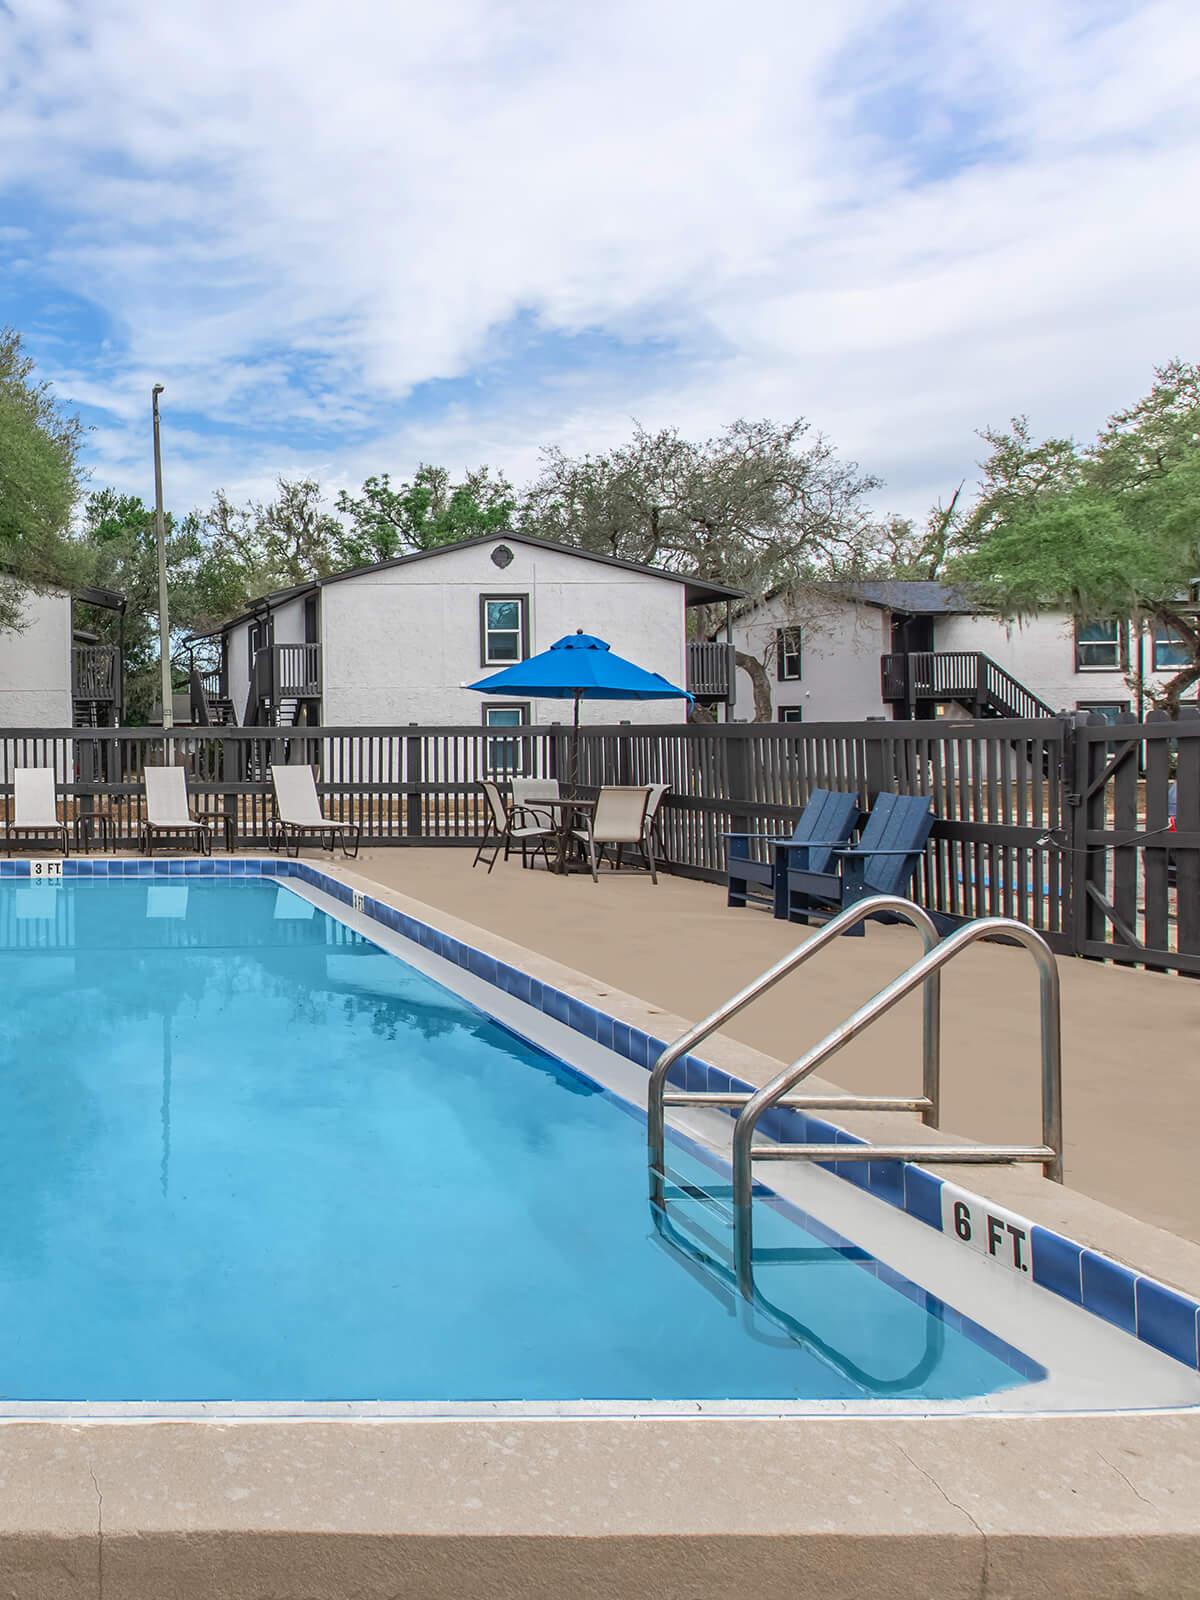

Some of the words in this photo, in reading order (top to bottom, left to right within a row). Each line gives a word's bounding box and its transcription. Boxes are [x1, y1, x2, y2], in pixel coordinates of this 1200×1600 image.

[35, 863, 42, 874] 3
[953, 1201, 971, 1242] 6
[986, 1214, 1028, 1272] FT.
